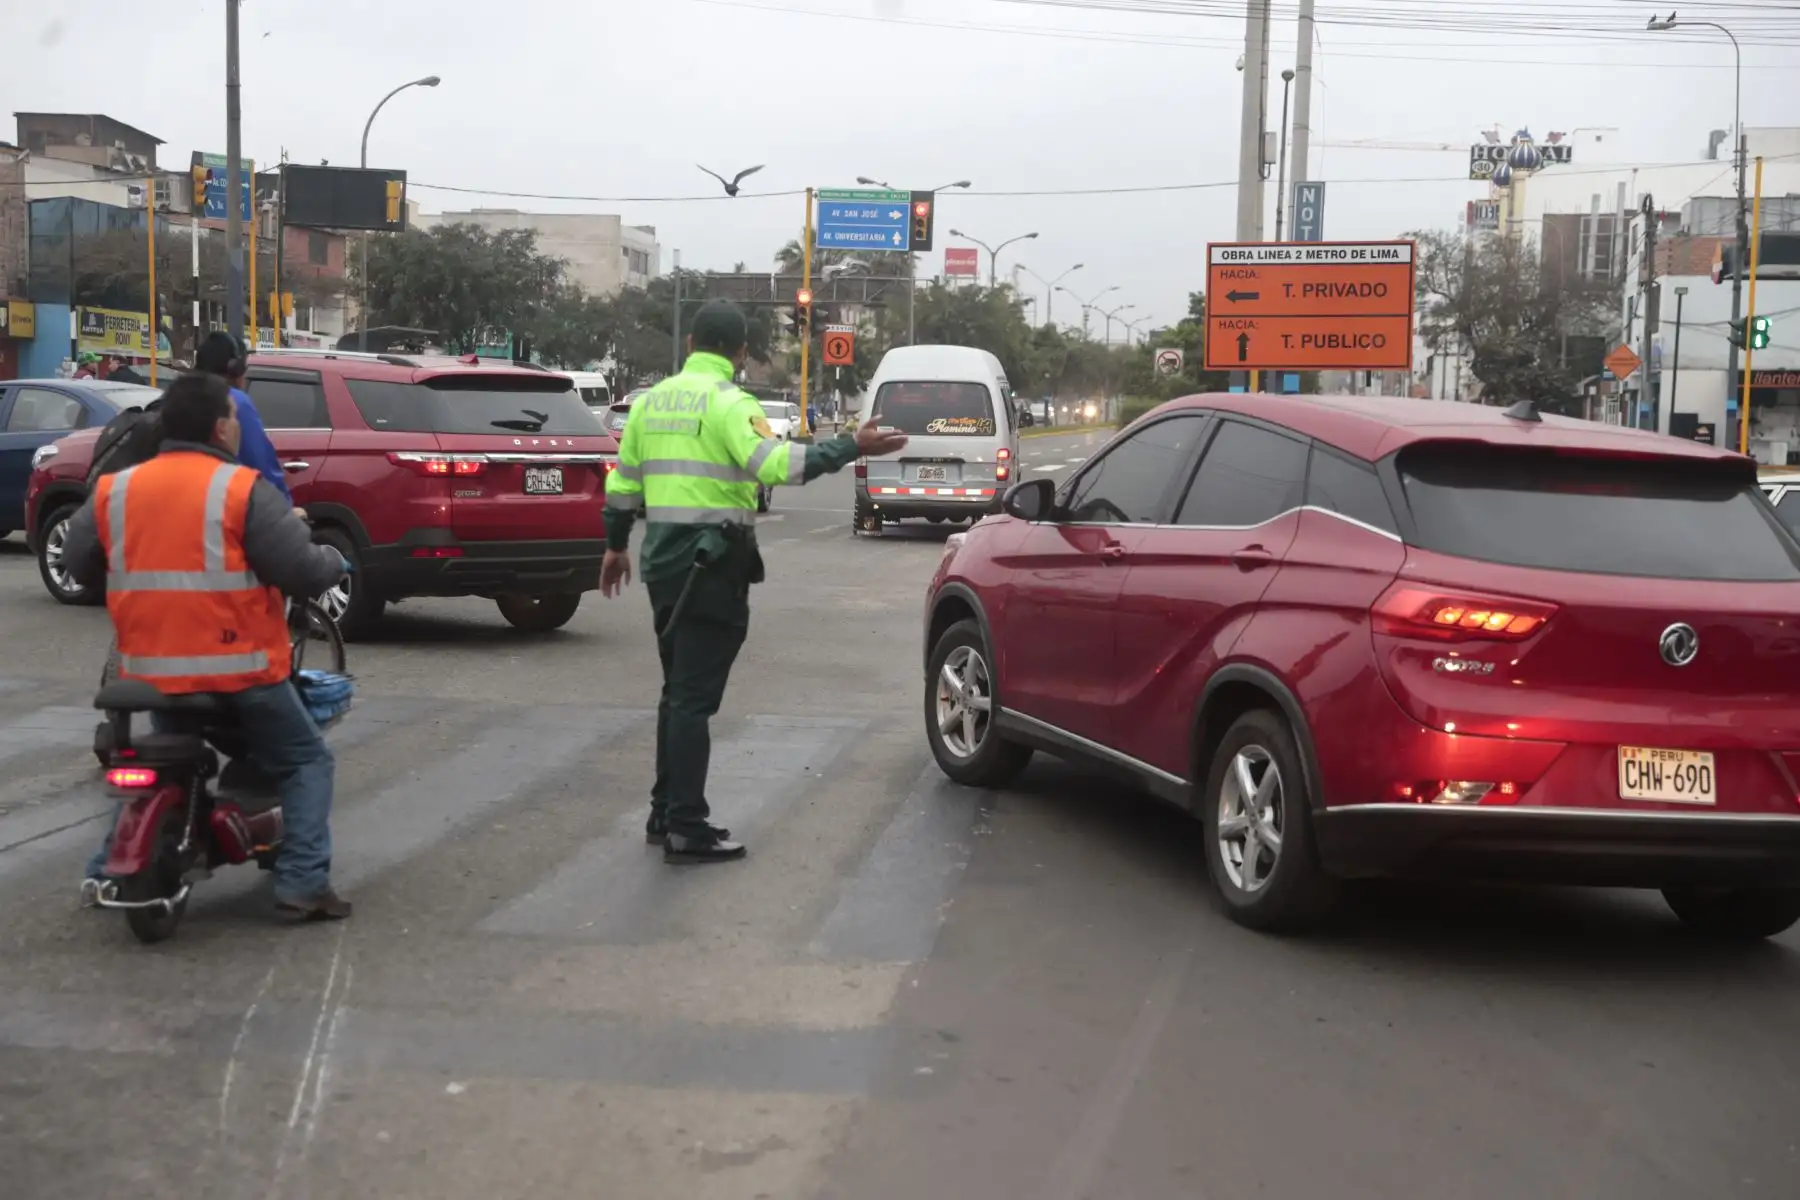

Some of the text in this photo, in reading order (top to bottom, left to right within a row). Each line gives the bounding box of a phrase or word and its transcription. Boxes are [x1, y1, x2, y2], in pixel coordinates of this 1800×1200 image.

[835, 231, 886, 242] UNIVERSITARIA
[1221, 249, 1400, 260] OBRA LINEA 2 METRO DE LIMA
[1220, 269, 1260, 279] HACIA:
[1282, 282, 1388, 298] T. PRIVADO
[1219, 320, 1260, 330] HACIA:
[1281, 333, 1387, 349] T. PUBLICO
[526, 474, 562, 489] CRH-434
[1651, 750, 1684, 762] PERU
[1625, 759, 1711, 795] CHW-690
